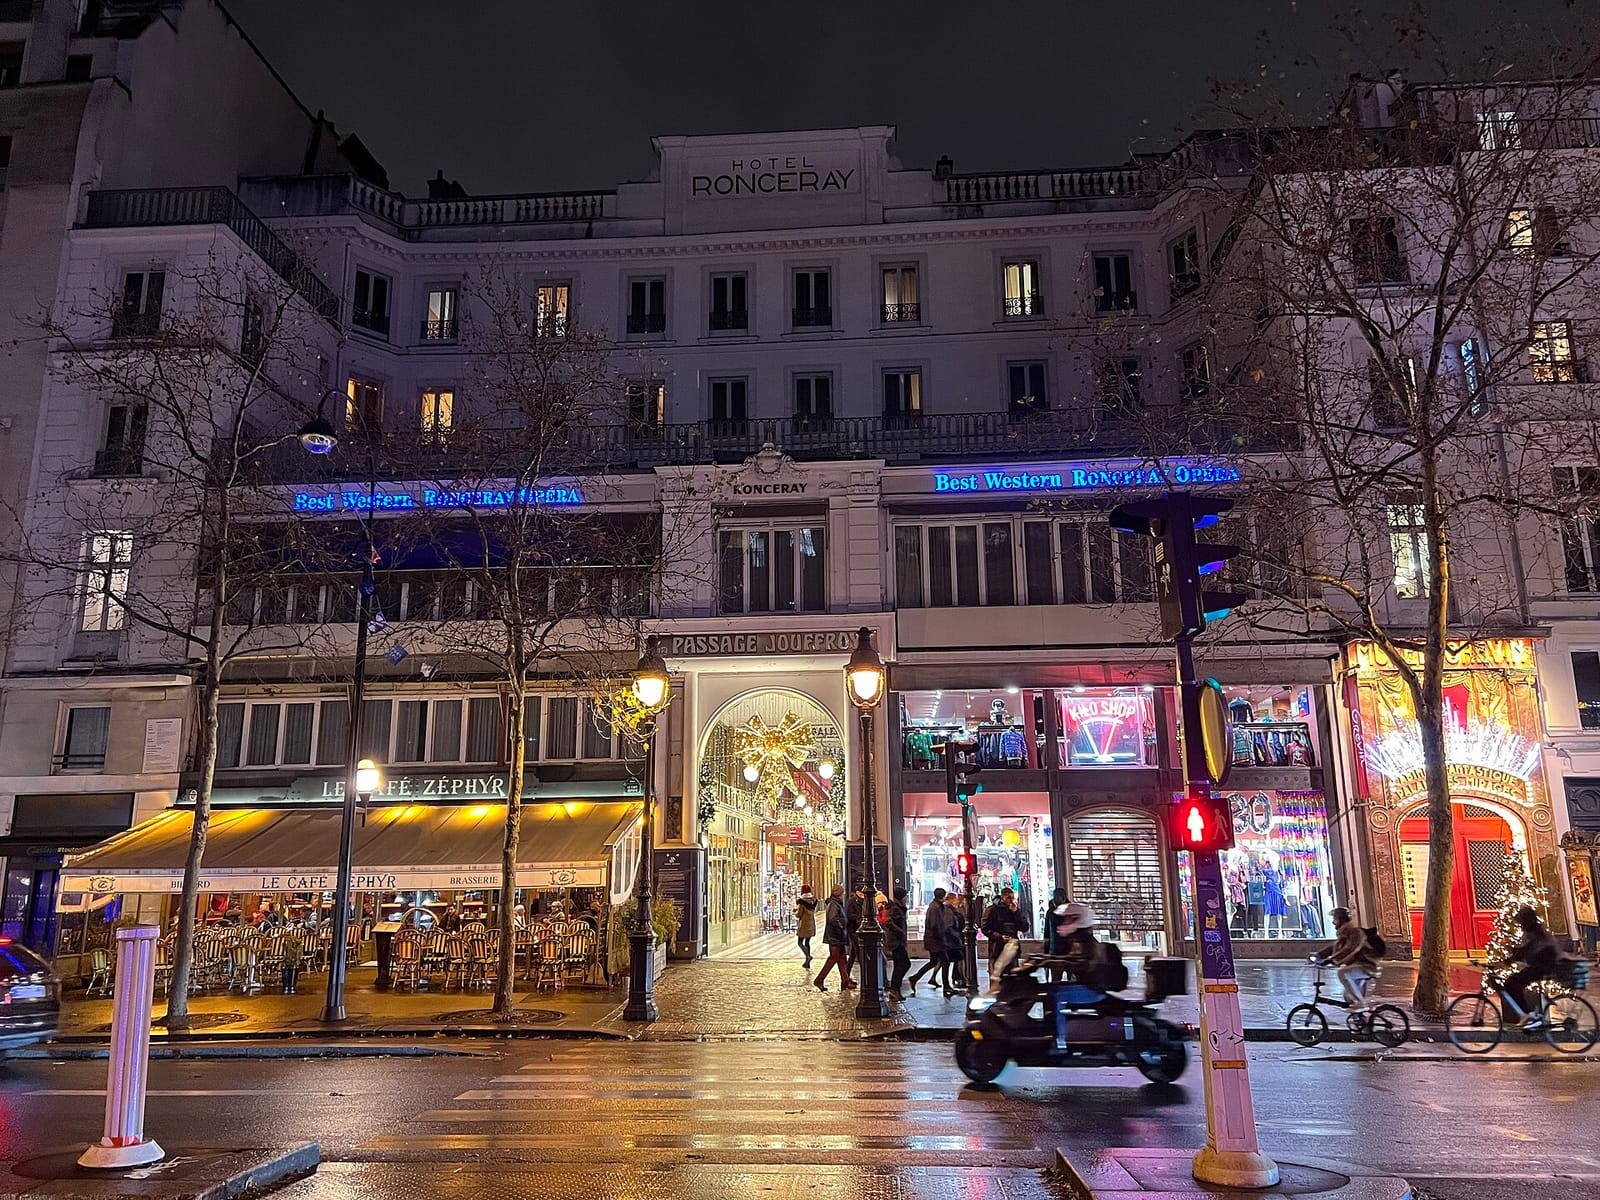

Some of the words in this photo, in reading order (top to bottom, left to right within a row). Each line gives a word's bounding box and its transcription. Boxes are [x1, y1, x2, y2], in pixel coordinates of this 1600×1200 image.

[732, 156, 814, 171] HOTEL
[692, 168, 855, 196] RONCERAY
[733, 482, 808, 495] RONCERAY
[935, 472, 977, 491] Best
[984, 469, 1062, 490] Western
[293, 491, 334, 510] Best
[341, 490, 413, 508] Western
[672, 634, 758, 655] PASSAGE
[1101, 700, 1136, 719] SHOP
[1446, 764, 1518, 786] ANTASTIQUE
[322, 781, 346, 797] LE
[423, 775, 506, 797] ZÉPHYR
[1395, 780, 1427, 800] PALAI
[1447, 776, 1461, 789] ES
[1465, 776, 1517, 797] MIRAGES
[262, 877, 280, 889] LE
[287, 874, 328, 889] CAFÉ
[449, 876, 499, 885] BRASSERIE
